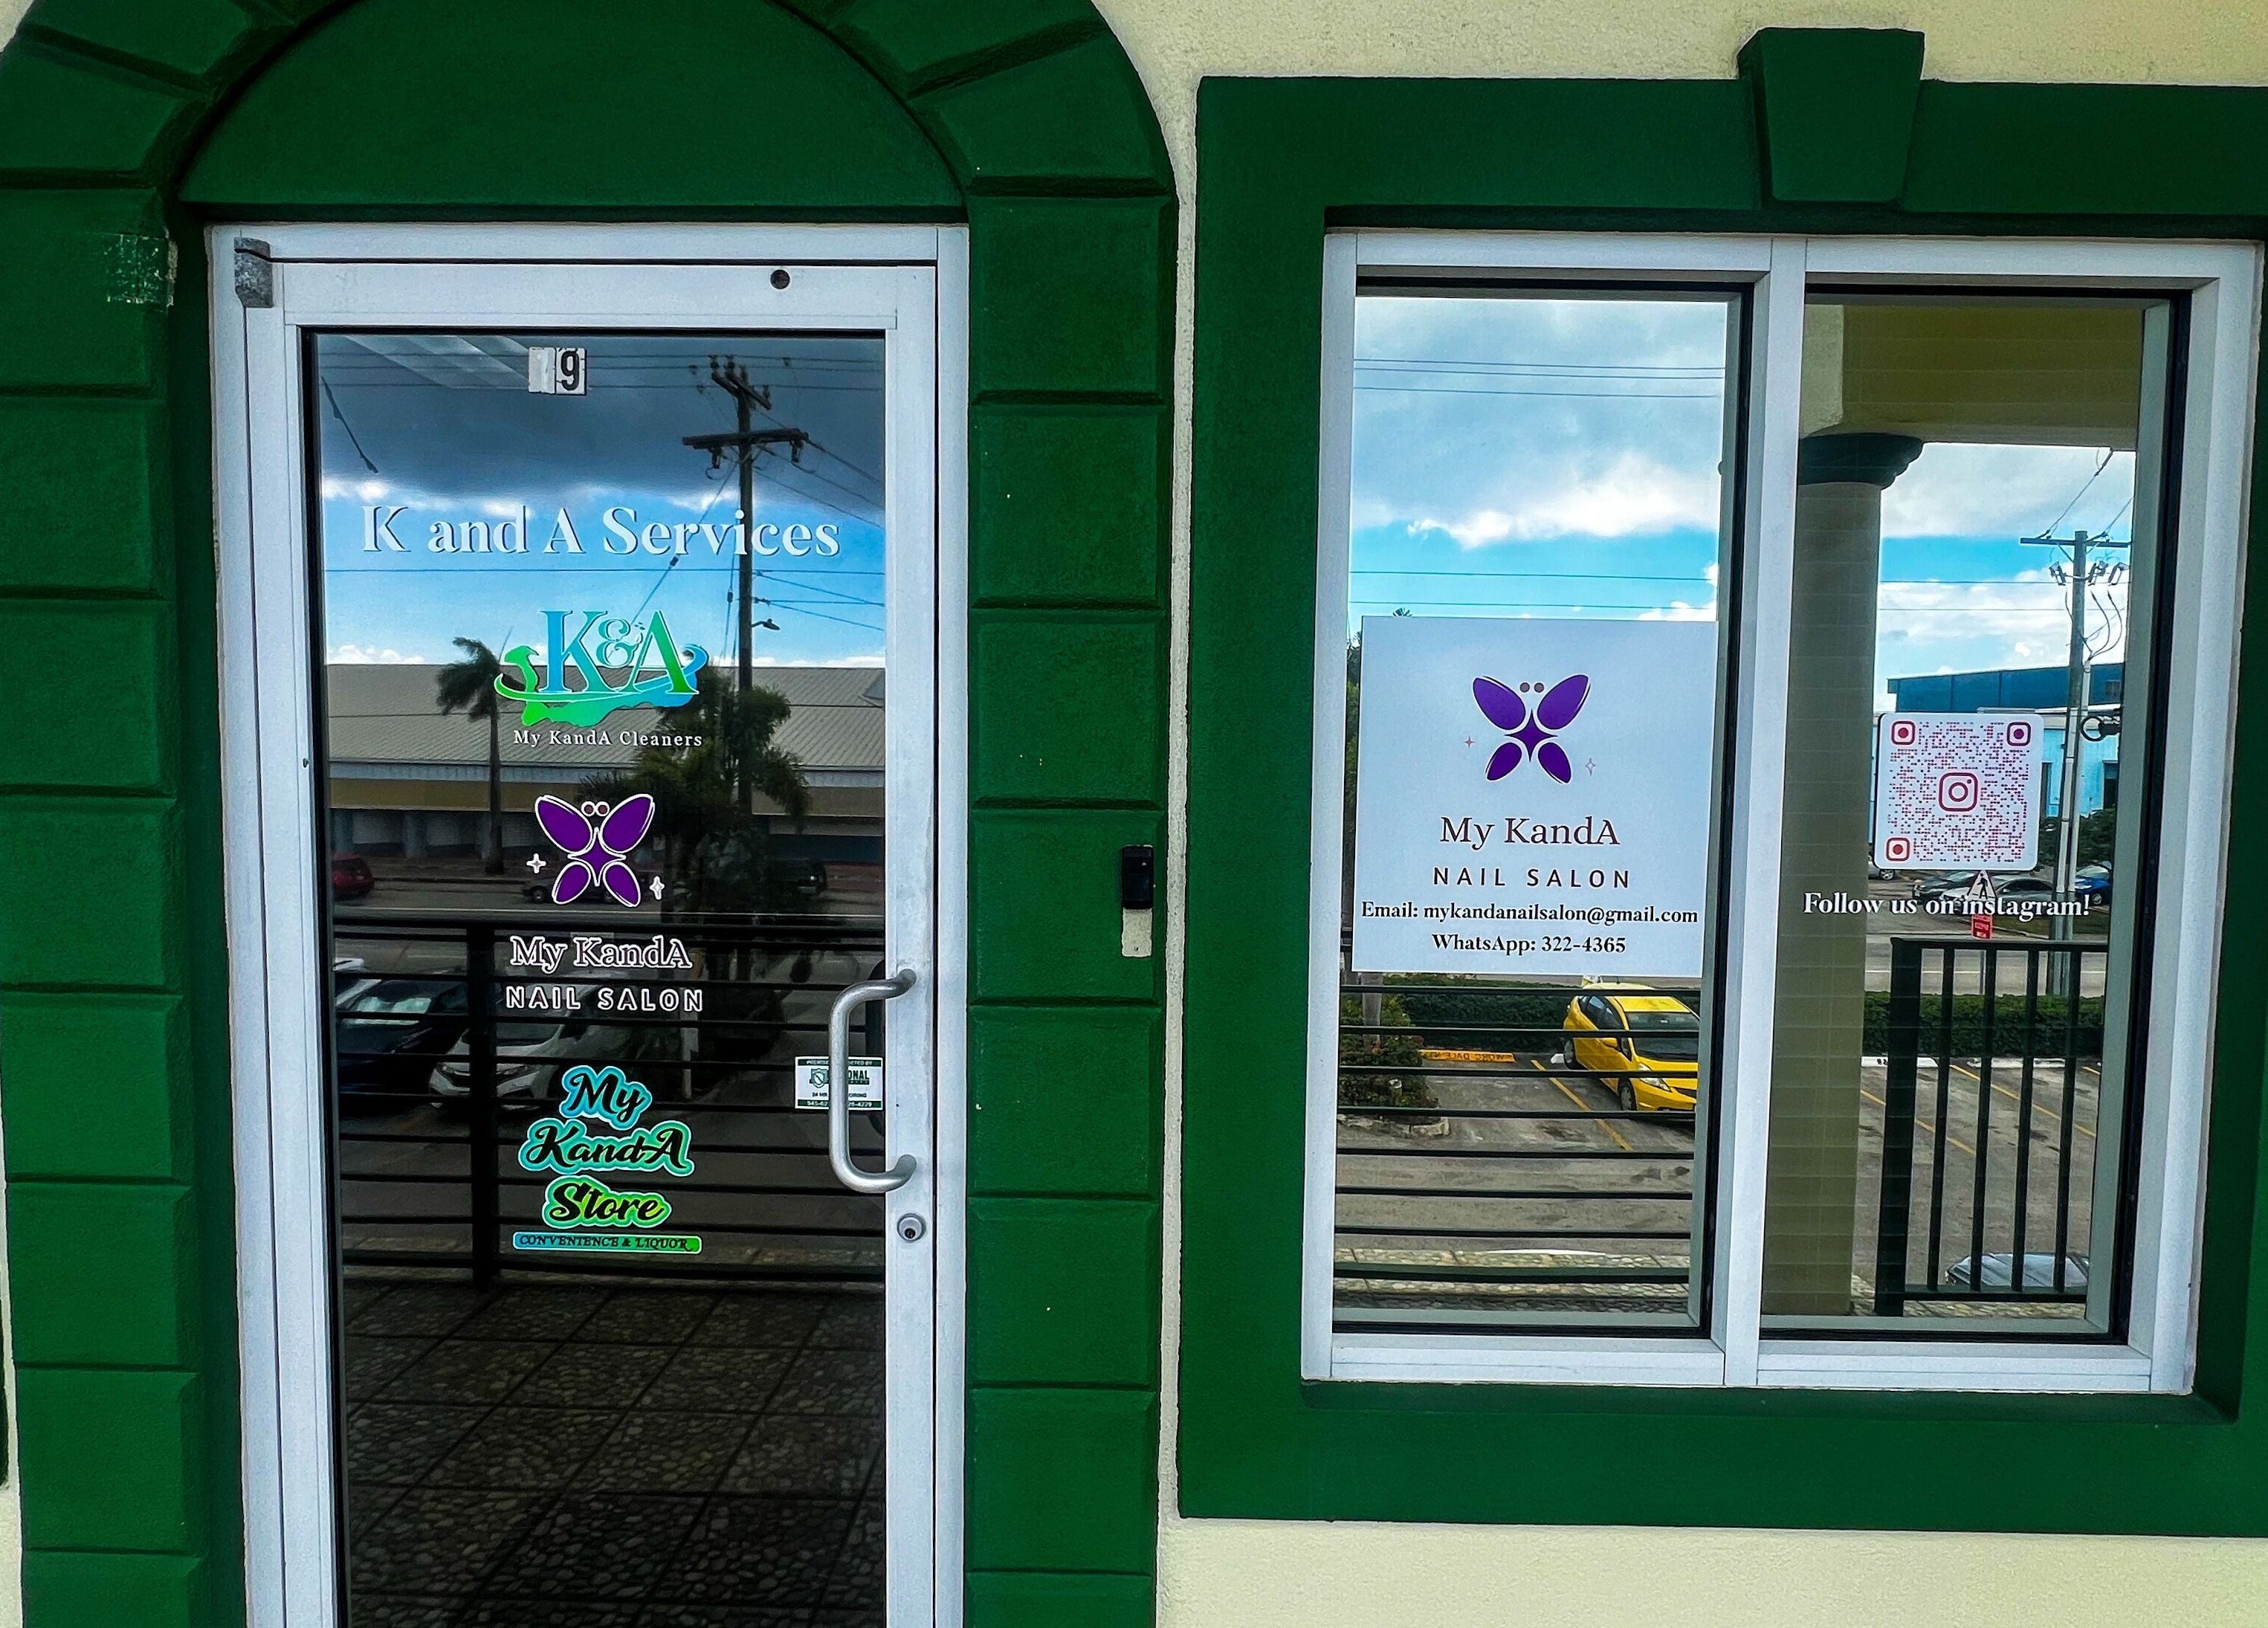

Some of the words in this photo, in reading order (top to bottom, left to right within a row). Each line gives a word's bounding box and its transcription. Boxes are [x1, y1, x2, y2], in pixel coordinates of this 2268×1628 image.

[361, 505, 410, 553] K
[427, 505, 528, 555] and
[543, 507, 584, 555] A
[603, 505, 840, 557] Services
[540, 610, 700, 695] K&A
[513, 729, 541, 747] My
[549, 729, 612, 746] KandA
[620, 730, 703, 747] Cleaners
[1440, 815, 1496, 850] My
[1504, 815, 1621, 845] KandA
[1433, 867, 1505, 886] NAIL
[1526, 868, 1629, 888] SALON
[1361, 901, 1418, 919] Email:
[1424, 902, 1698, 927] mykandanailsalon@gmail.com
[1803, 892, 1882, 914] Follow
[1891, 897, 1917, 915] us
[1925, 899, 1955, 915] on
[510, 935, 568, 974] My
[572, 934, 692, 969] KandA
[1432, 934, 1536, 955] WhatsApp:
[1541, 936, 1626, 954] 322-4365
[506, 986, 581, 1010] NAIL
[597, 987, 703, 1012] SALON
[565, 1071, 646, 1122] My
[526, 1124, 688, 1169] KandA
[549, 1182, 665, 1222] Store
[621, 1238, 631, 1247] &
[635, 1238, 692, 1251] LIQUOR
